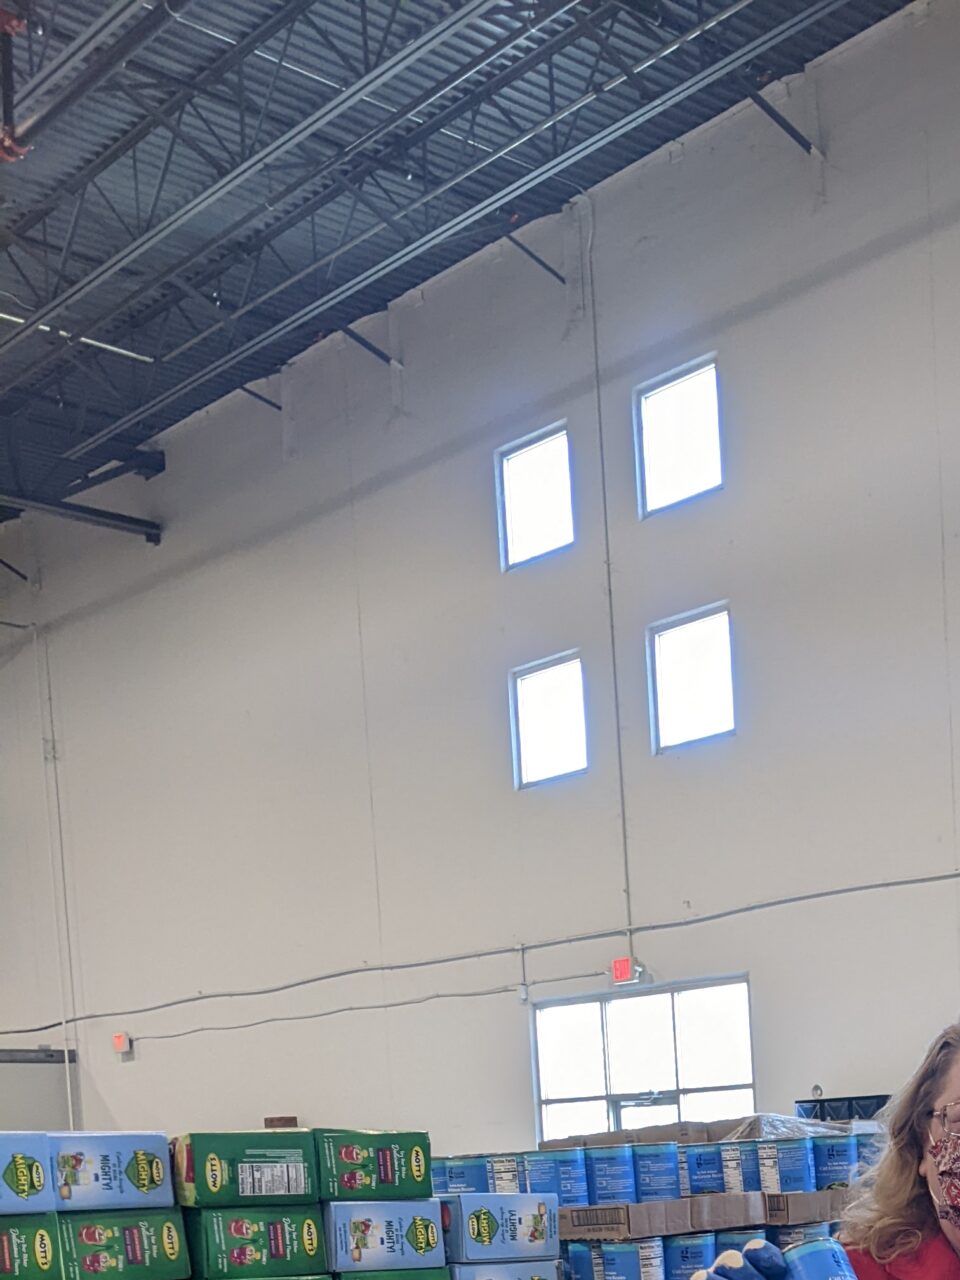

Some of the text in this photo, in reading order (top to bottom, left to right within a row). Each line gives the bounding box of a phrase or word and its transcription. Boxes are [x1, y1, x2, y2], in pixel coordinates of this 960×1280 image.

[14, 1153, 28, 1200] MIGHTY
[100, 1154, 113, 1191] MIGHTY!
[134, 1150, 149, 1194] MIGHTY
[208, 1157, 218, 1188] MOTT'S
[414, 1149, 422, 1178] MOTT'S
[166, 1226, 175, 1257] MOTT'S
[384, 1220, 396, 1254] MIGHTY!
[414, 1216, 425, 1256] MIGHTY
[481, 1207, 492, 1246] MIGHTY
[508, 1210, 517, 1241] MIGHTY!
[39, 1233, 48, 1267] MOTT'S
